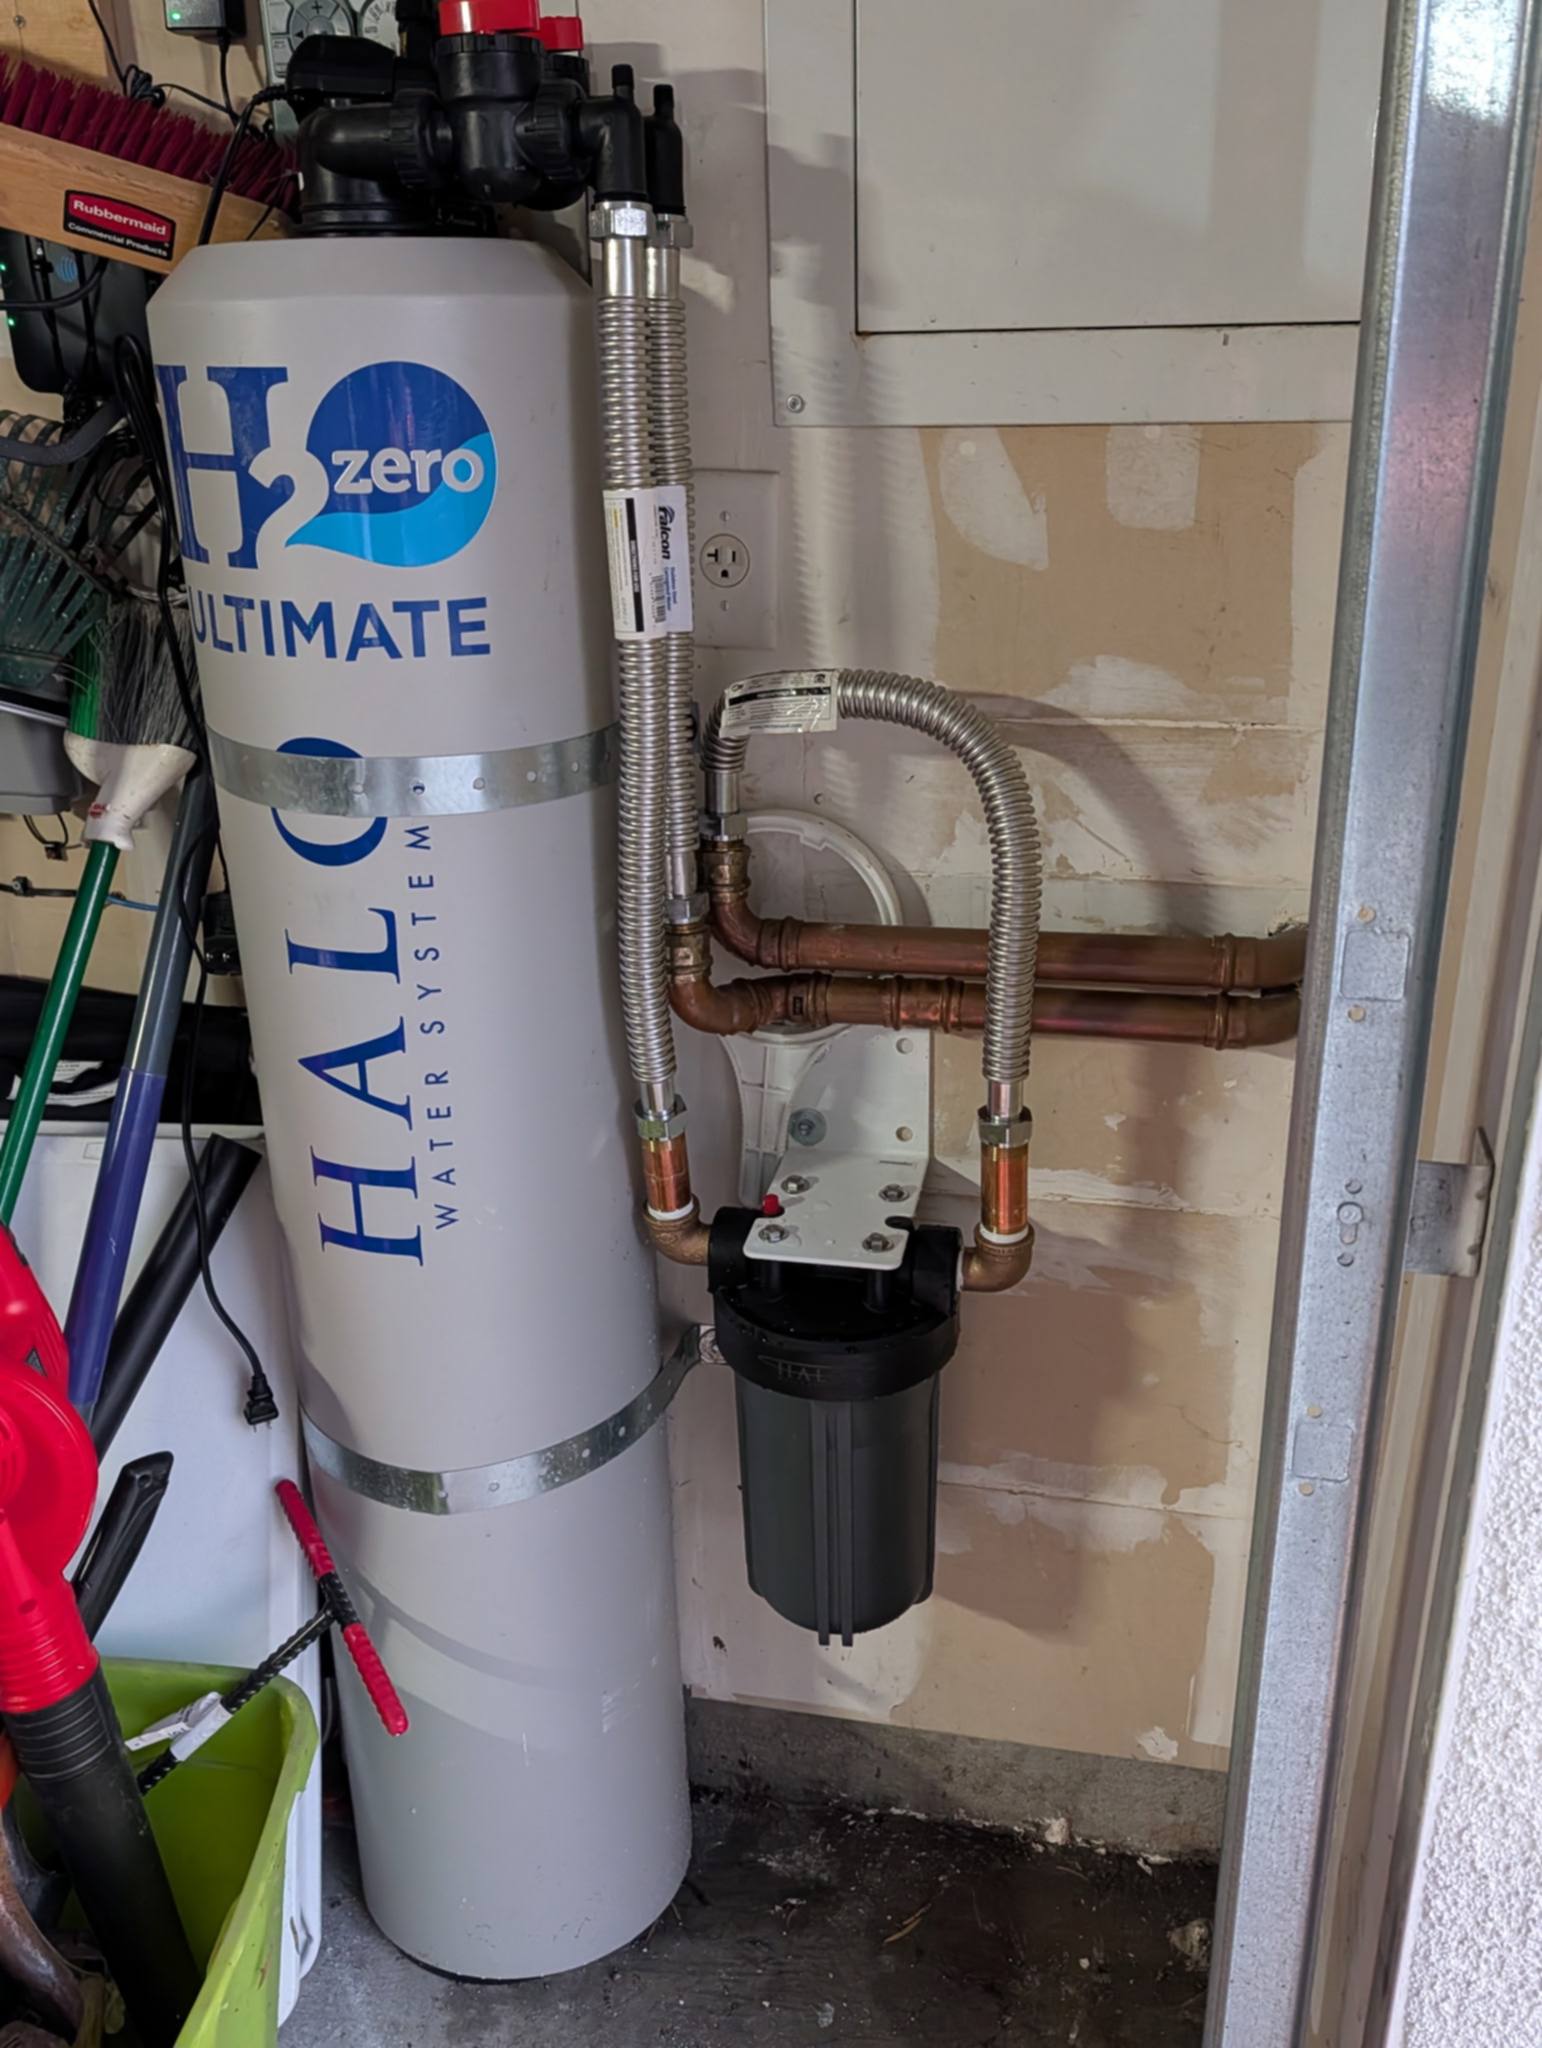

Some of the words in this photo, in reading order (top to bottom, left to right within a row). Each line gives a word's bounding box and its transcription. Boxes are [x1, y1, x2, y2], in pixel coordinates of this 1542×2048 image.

[67, 222, 125, 245] Commercial
[126, 238, 168, 257] Products
[73, 200, 166, 235] Rubbermaid
[331, 446, 486, 495] zero
[659, 505, 675, 560] Falcon
[187, 584, 491, 662] ULTIMATE
[404, 784, 446, 1036] SYSTEM
[271, 737, 424, 1267] HALO
[424, 1070, 459, 1231] WATER
